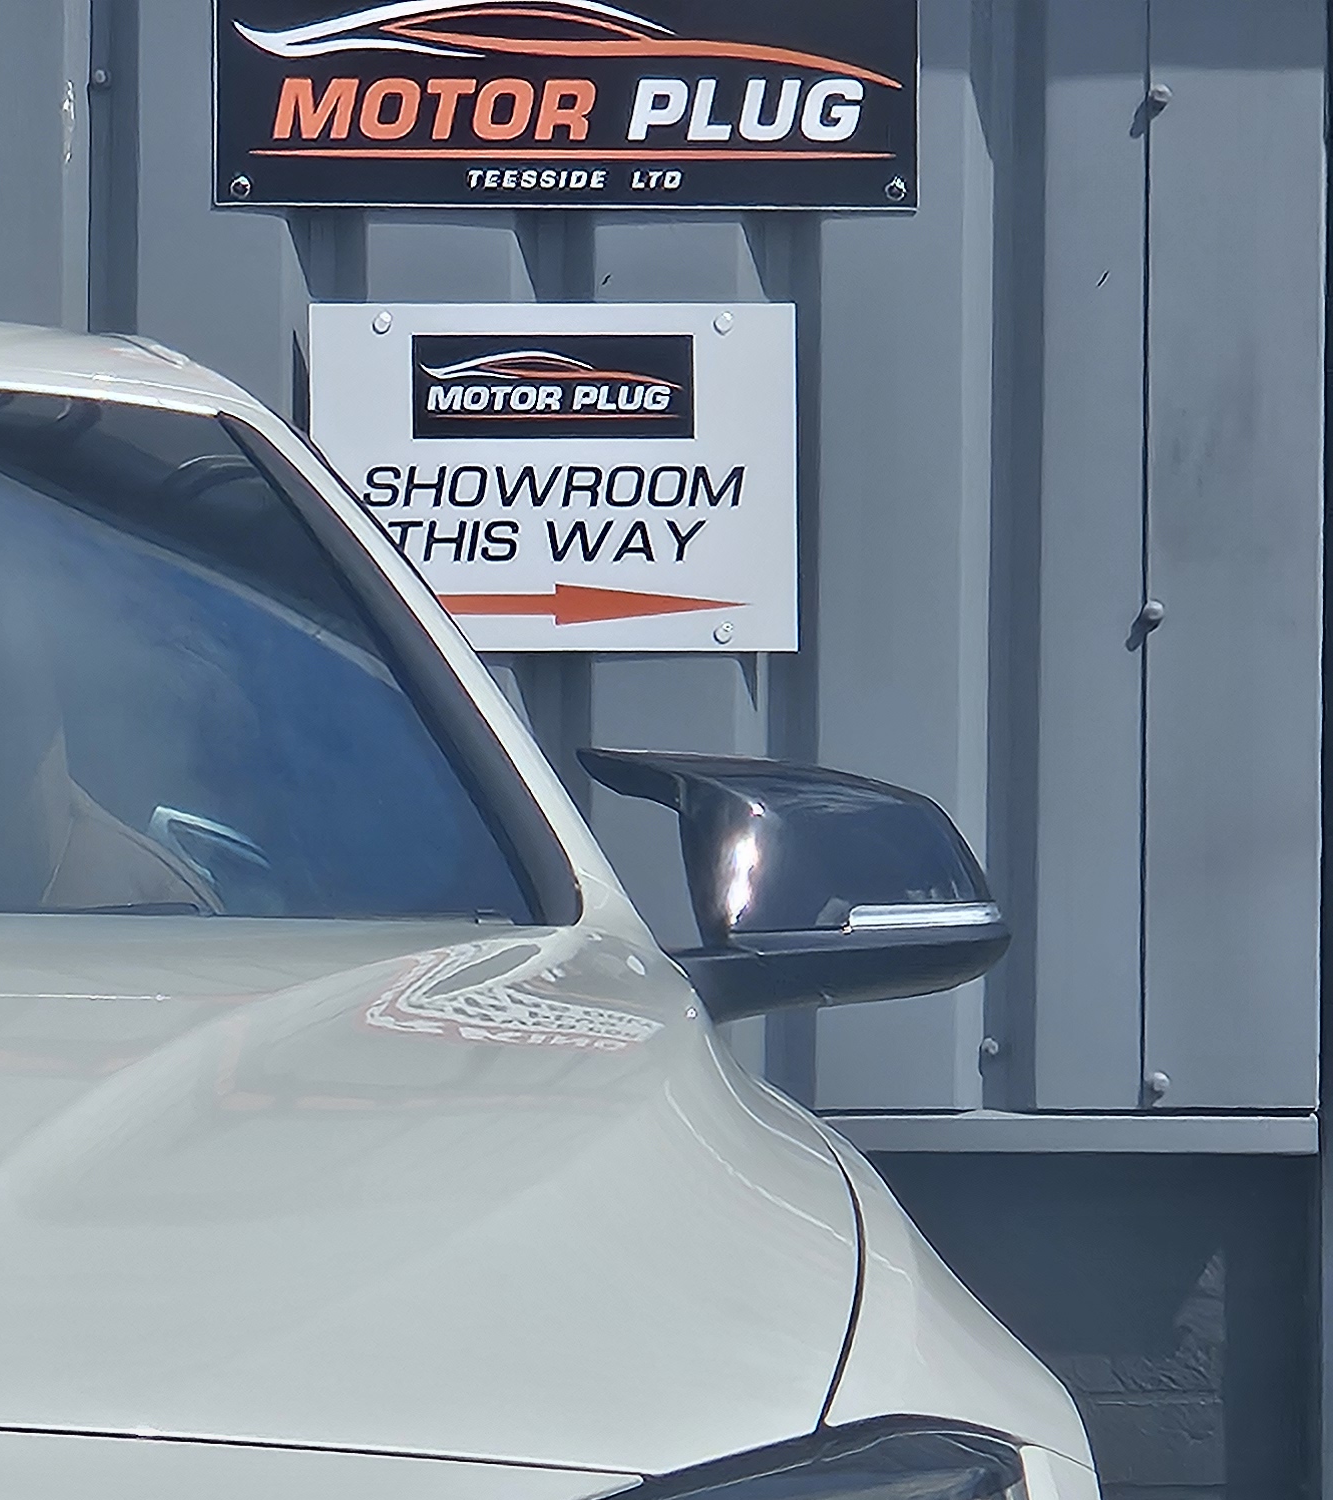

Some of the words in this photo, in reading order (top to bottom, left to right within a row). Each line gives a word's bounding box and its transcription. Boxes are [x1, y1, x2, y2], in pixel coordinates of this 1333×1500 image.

[272, 77, 597, 141] MOTOR
[626, 77, 864, 142] PLUG
[466, 169, 608, 190] TEESSIDE
[631, 169, 683, 190] LTD
[427, 385, 563, 412] MOTOR
[572, 385, 671, 412] PLUG
[363, 465, 746, 508] SHOWROOM
[387, 519, 519, 563] THIS
[545, 519, 706, 563] WAY
